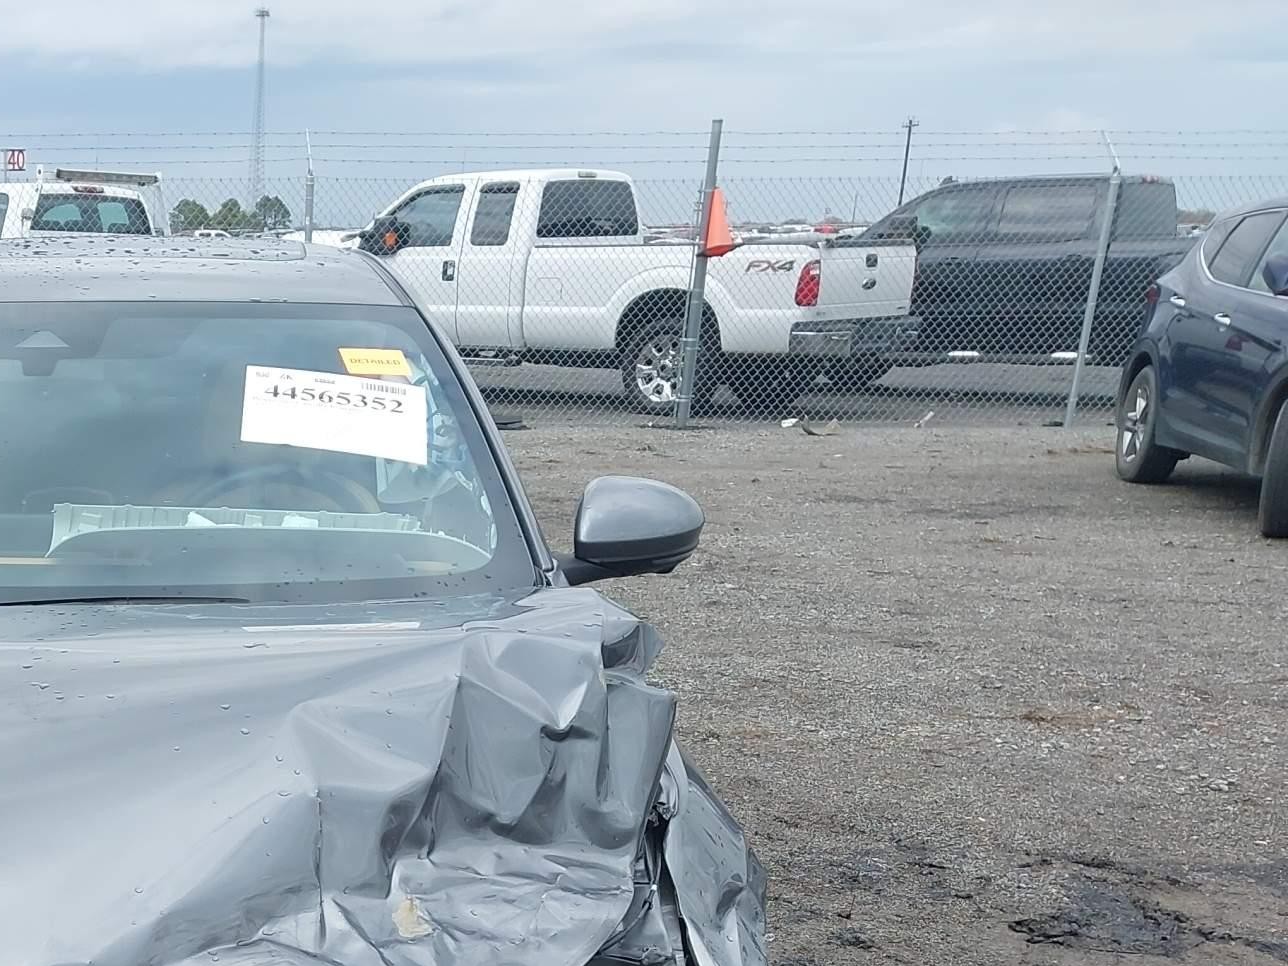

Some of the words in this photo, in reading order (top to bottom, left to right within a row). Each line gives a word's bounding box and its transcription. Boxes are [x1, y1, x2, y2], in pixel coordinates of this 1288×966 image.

[8, 150, 26, 170] 40
[745, 259, 796, 273] FX4
[263, 384, 405, 414] 44565352
